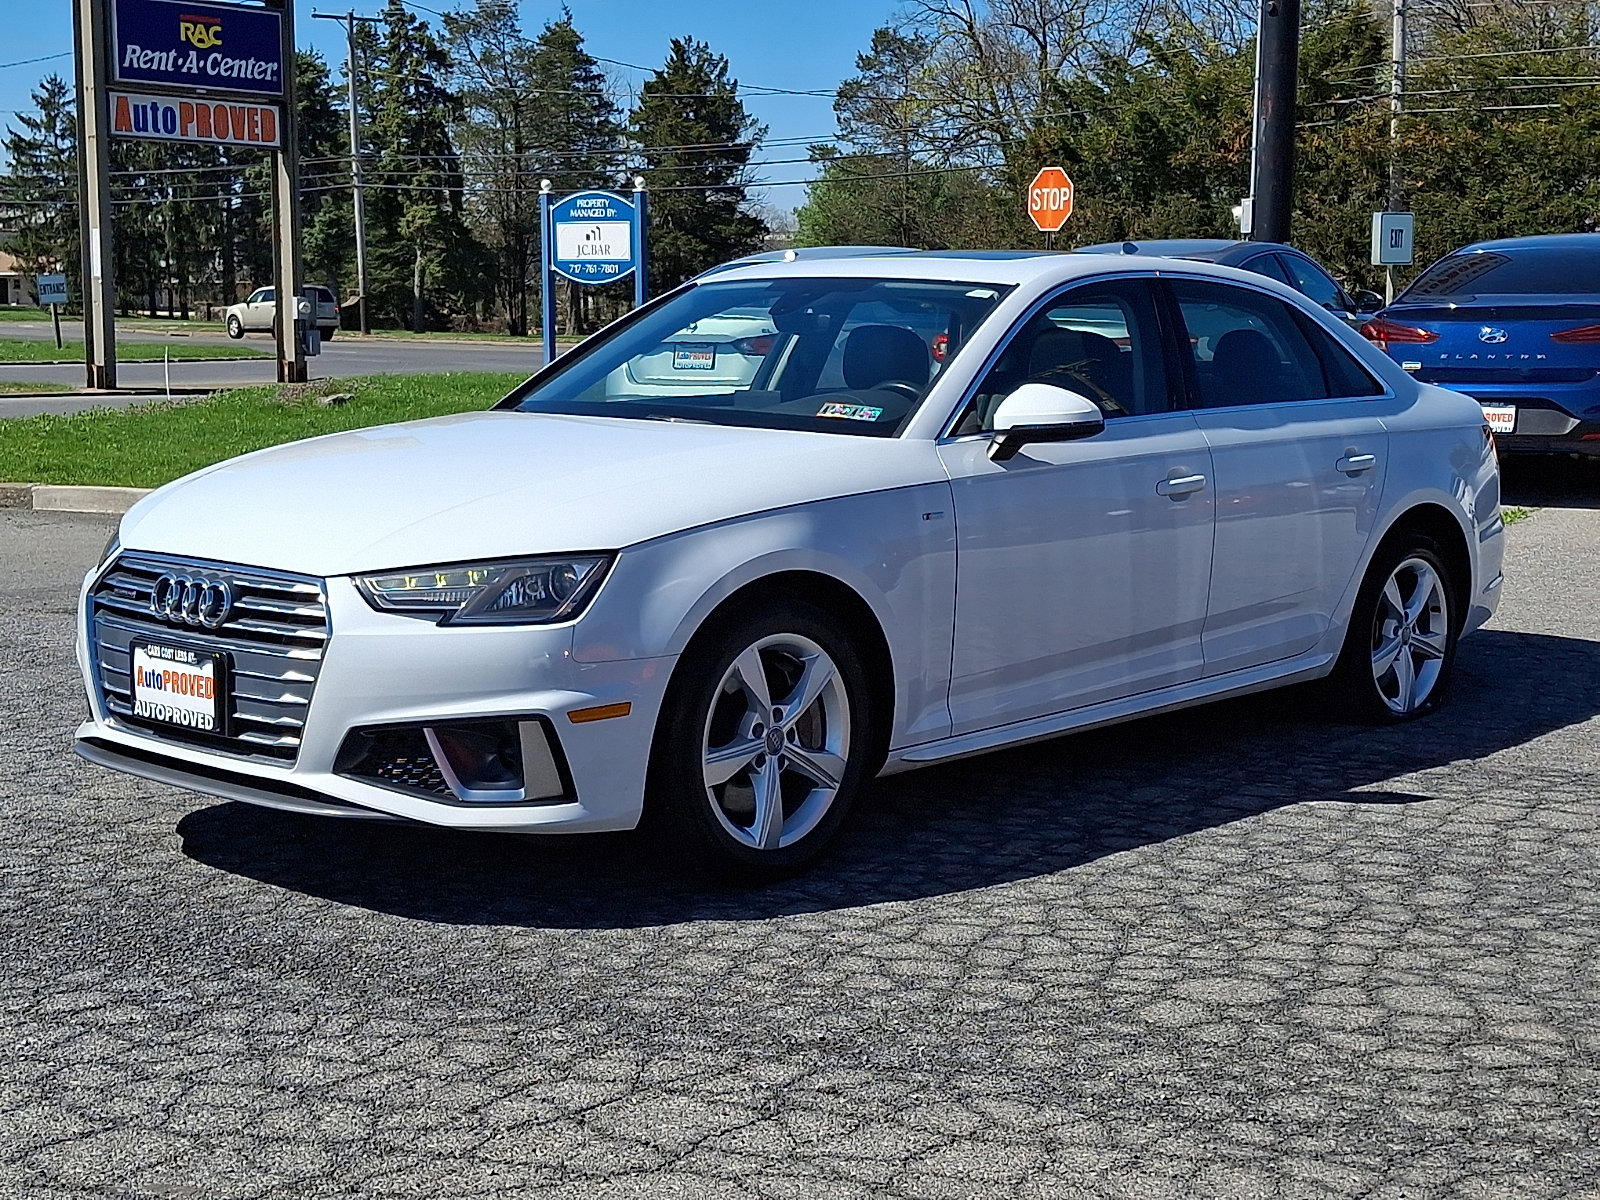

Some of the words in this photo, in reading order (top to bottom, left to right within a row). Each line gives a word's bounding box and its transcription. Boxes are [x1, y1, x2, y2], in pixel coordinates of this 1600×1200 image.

[180, 22, 222, 48] RAC
[115, 96, 276, 143] AutoPROVED
[576, 199, 610, 207] PROPERTY
[1032, 187, 1070, 211] STOP
[570, 208, 605, 217] MANAGED
[606, 208, 618, 217] BY:
[1390, 229, 1404, 249] EXIT
[568, 264, 619, 274] 717-761-7801
[1439, 353, 1547, 361] ELANTRA
[147, 644, 161, 657] CARS
[160, 646, 175, 660] COST
[174, 649, 188, 663] LESS
[136, 665, 216, 700] AutoPROVED
[133, 700, 215, 731] AUTOPROVED
